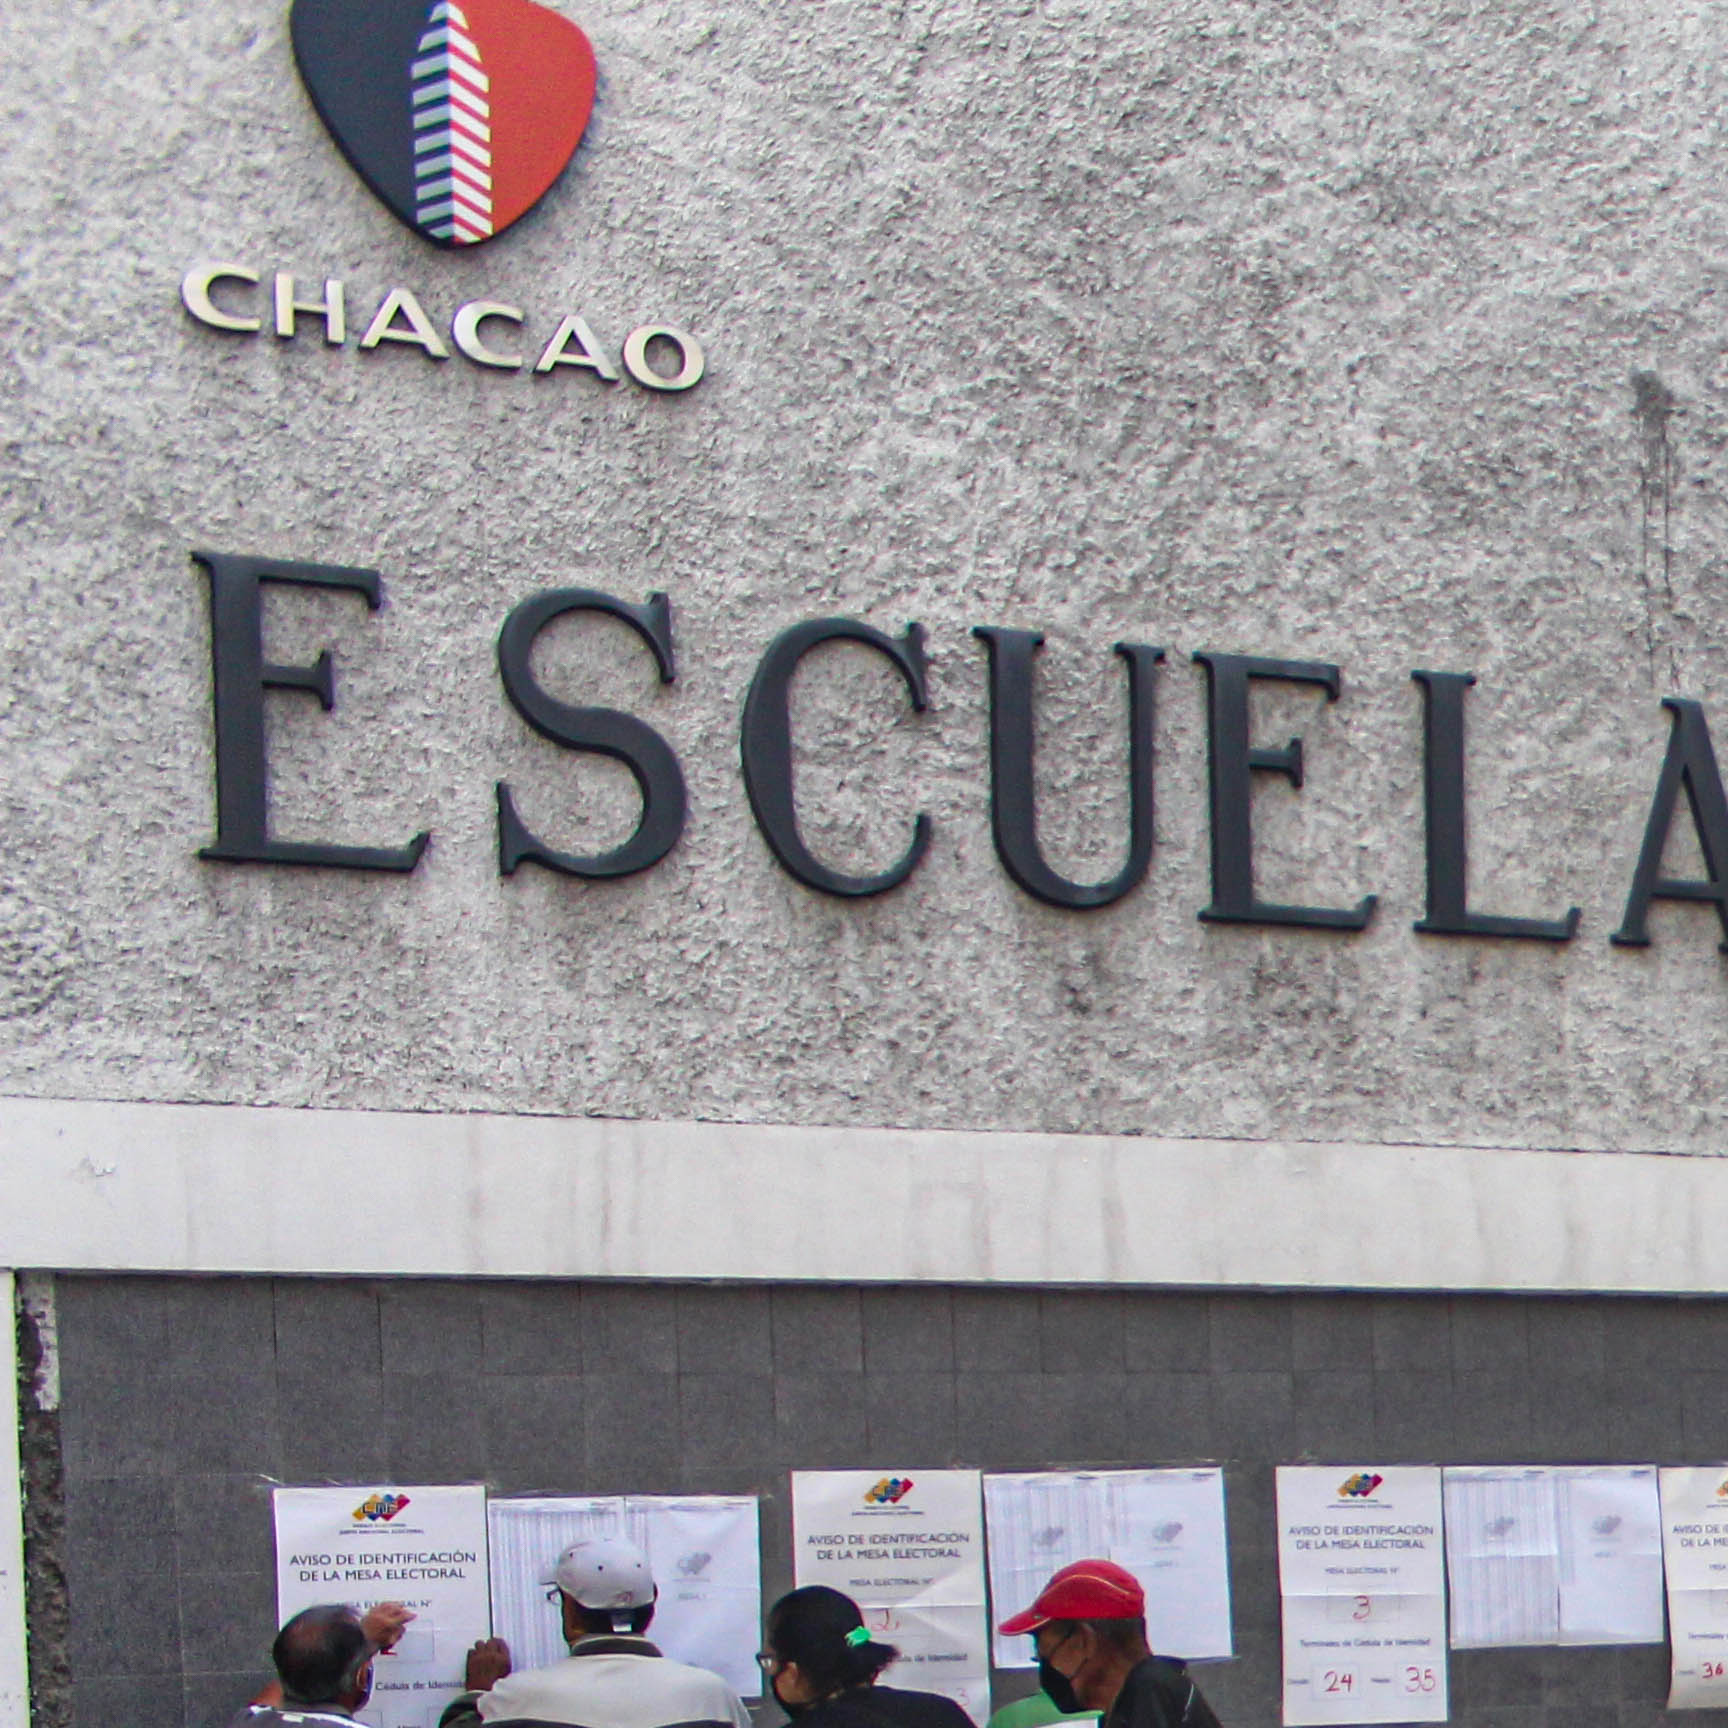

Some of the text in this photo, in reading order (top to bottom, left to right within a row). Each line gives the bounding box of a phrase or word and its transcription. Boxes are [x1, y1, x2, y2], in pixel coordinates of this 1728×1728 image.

[180, 261, 706, 391] CHACAO
[1289, 1525, 1321, 1536] AVISO
[1324, 1525, 1340, 1536] DE
[807, 1534, 845, 1546] AVISO
[848, 1534, 865, 1545] DE
[1296, 1539, 1425, 1550] DE LA MESA ELECTORAL
[289, 1549, 477, 1566] AVISO DE IDENTIFICACIÓN
[816, 1548, 961, 1561] DE LA MESA ELECTORAL
[299, 1567, 467, 1583] DE LA MESA ELECTORAL
[1352, 1595, 1371, 1620] 3
[1324, 1670, 1353, 1693] 24
[1406, 1666, 1436, 1693] 35
